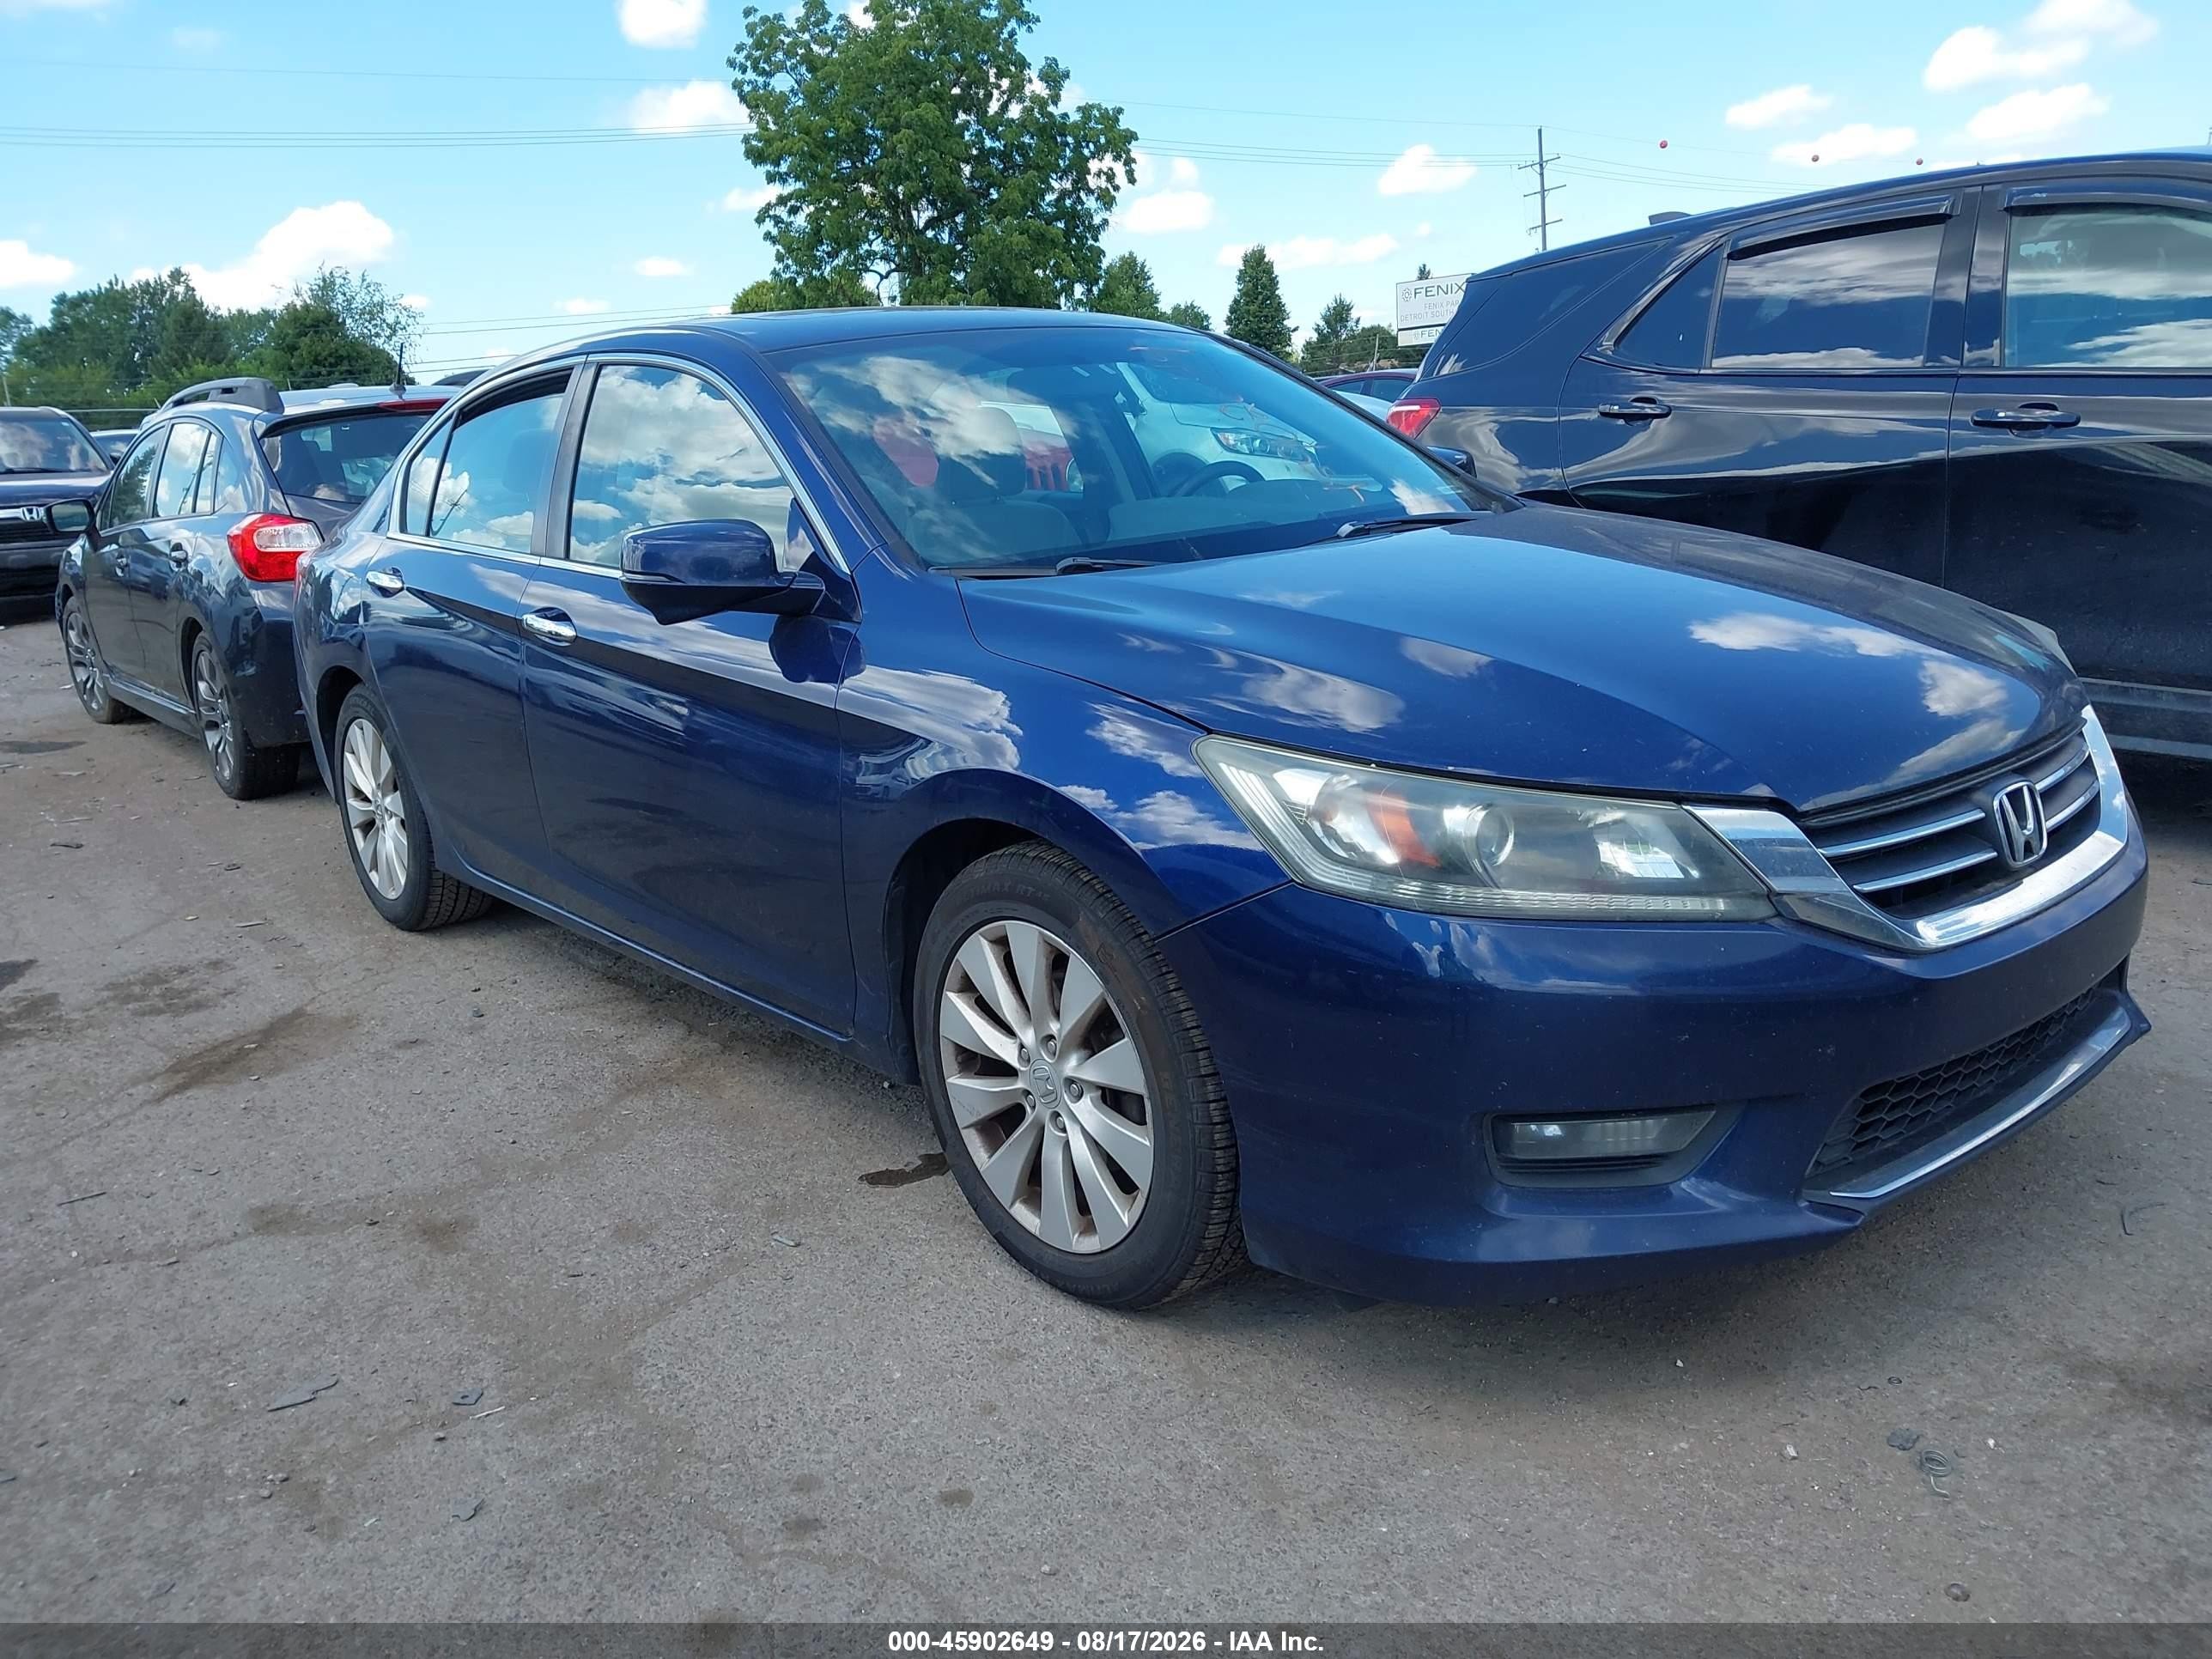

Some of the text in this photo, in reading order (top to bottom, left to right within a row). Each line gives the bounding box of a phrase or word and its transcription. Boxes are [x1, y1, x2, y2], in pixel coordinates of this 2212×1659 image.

[1413, 282, 1466, 299] FENIX
[1424, 301, 1444, 310] FENIX
[1400, 311, 1428, 322] DETROIT
